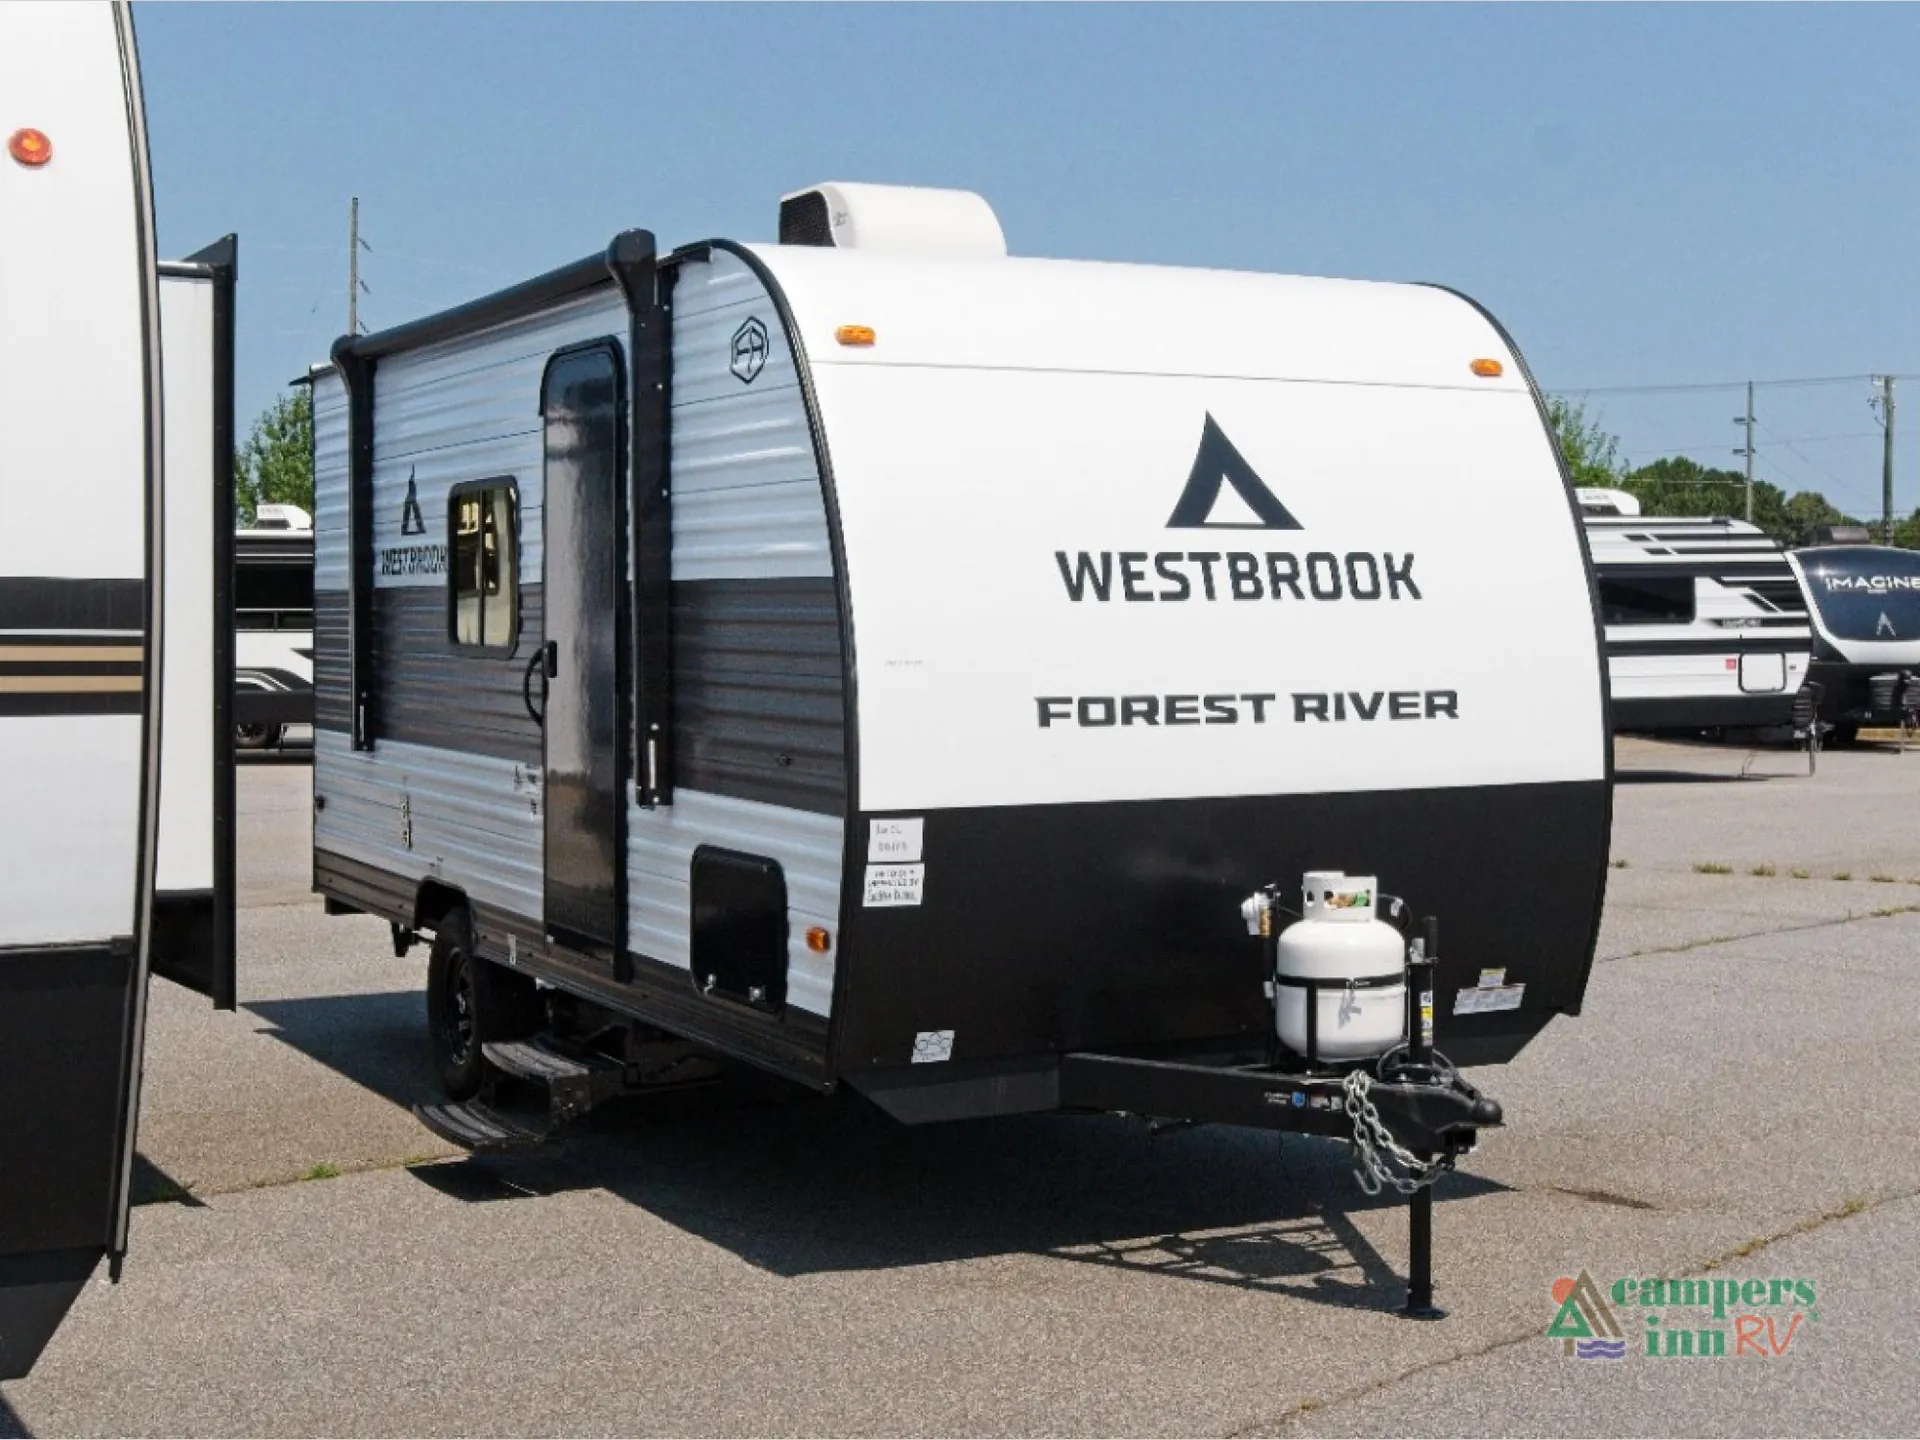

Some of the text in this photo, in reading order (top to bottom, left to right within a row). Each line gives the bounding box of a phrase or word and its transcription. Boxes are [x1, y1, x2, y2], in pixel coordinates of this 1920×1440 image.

[1055, 551, 1422, 602] WESTBROOK
[1826, 575, 1920, 591] IMAGINE
[1036, 691, 1458, 727] FOREST RIVER
